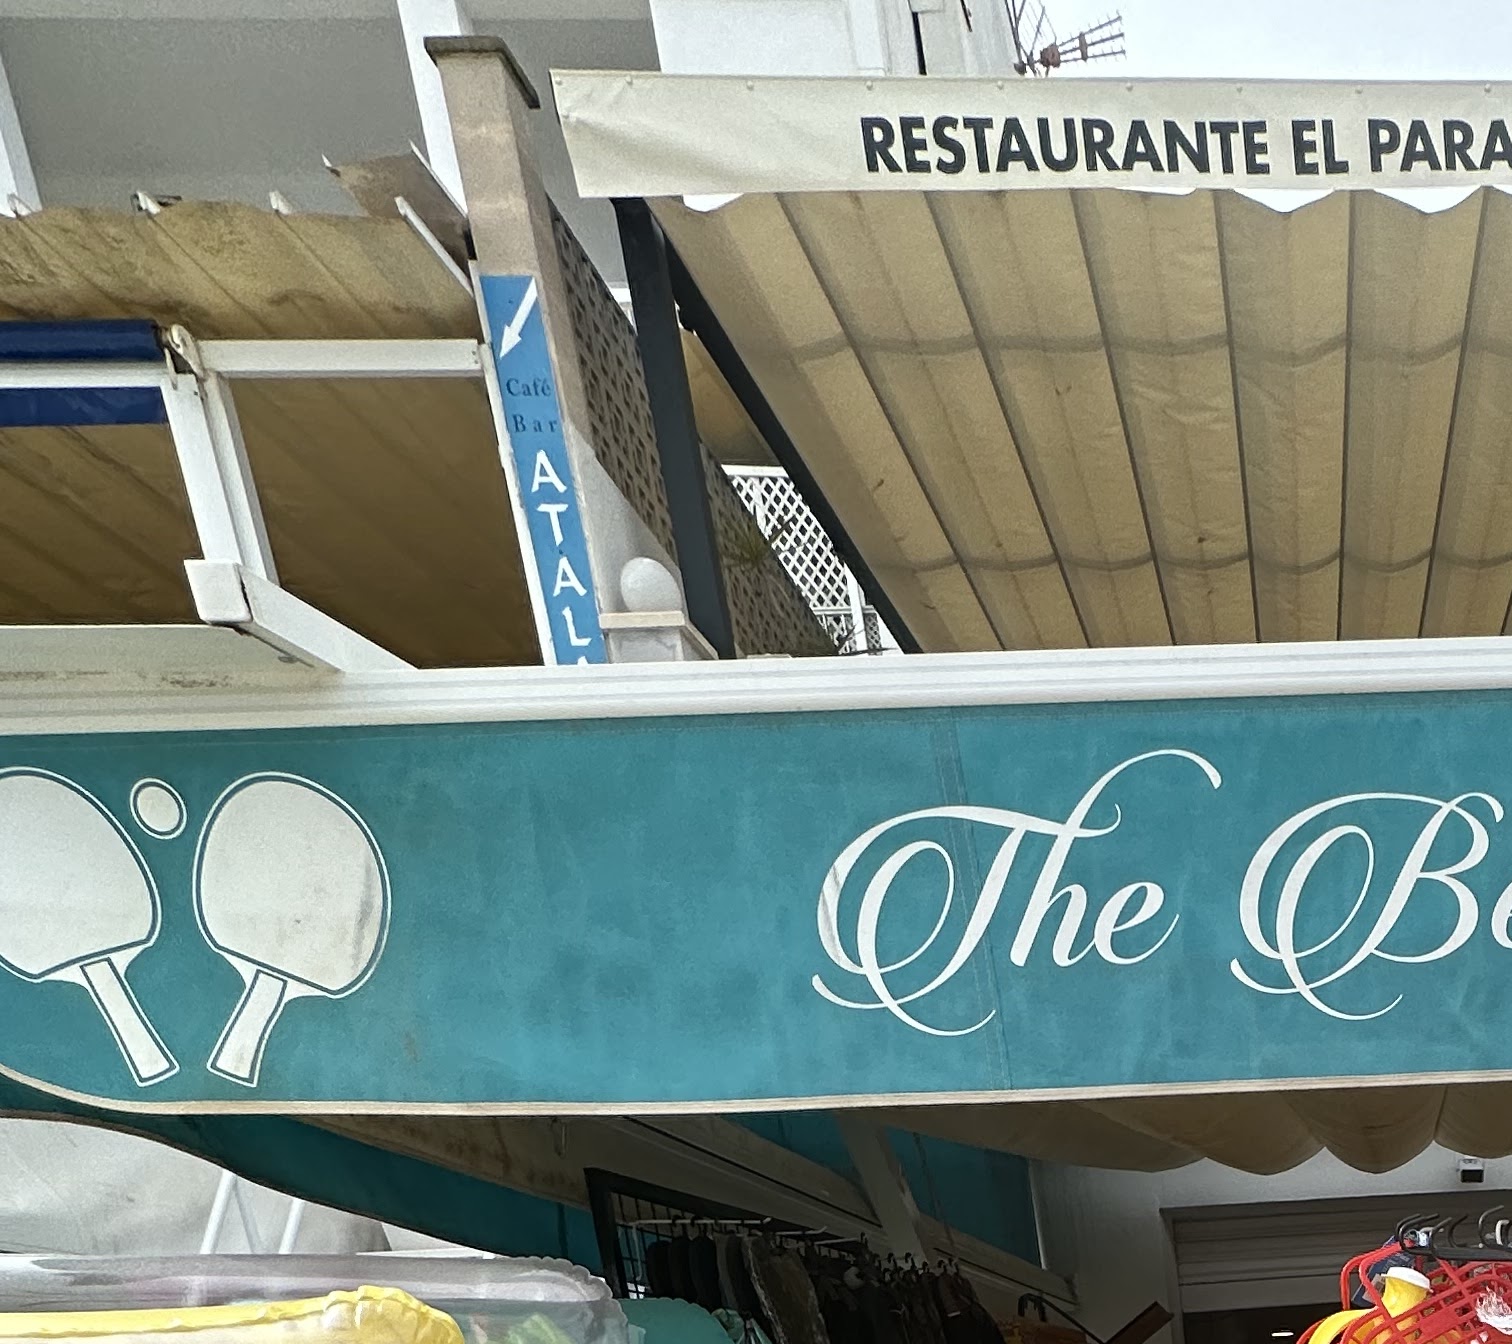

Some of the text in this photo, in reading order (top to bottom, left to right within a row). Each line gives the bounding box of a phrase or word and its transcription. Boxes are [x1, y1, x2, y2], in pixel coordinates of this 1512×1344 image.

[861, 115, 1270, 175] RESTAURANTE
[1292, 119, 1349, 175] EL
[506, 377, 552, 398] Café
[512, 413, 558, 435] Bar
[531, 449, 593, 665] ATAL
[811, 748, 1222, 1037] The
